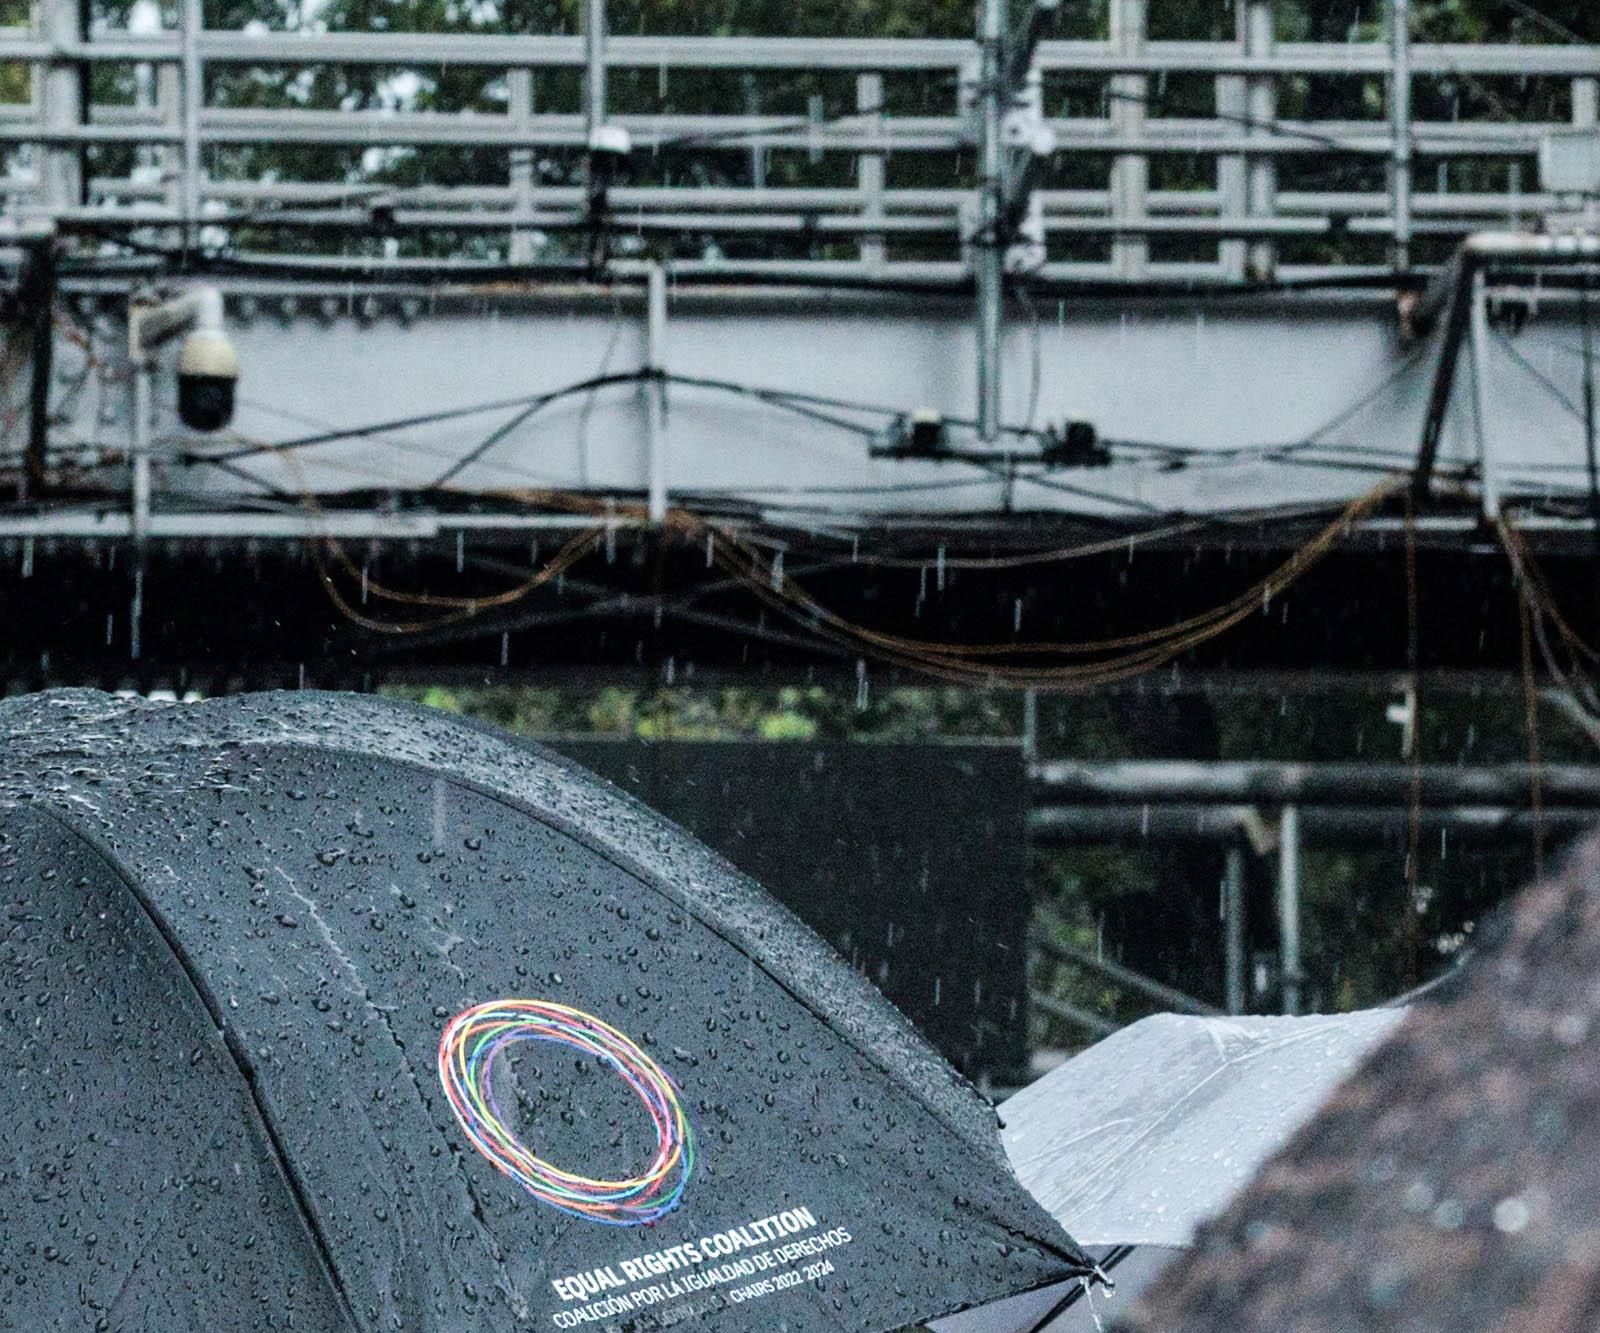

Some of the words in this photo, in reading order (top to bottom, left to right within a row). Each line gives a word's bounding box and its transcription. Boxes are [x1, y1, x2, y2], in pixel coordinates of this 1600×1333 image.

[552, 1266, 626, 1301] EQUAL
[619, 1243, 702, 1282] RIGHTS
[700, 1206, 816, 1258] COALITION
[553, 1295, 634, 1329] COALICIÓN
[630, 1286, 665, 1307] POR
[661, 1281, 684, 1298] LA
[680, 1259, 755, 1292] IGUALDAD
[752, 1251, 778, 1272] DE
[773, 1226, 852, 1264] DERECHOS
[730, 1279, 776, 1303] CHAIRS
